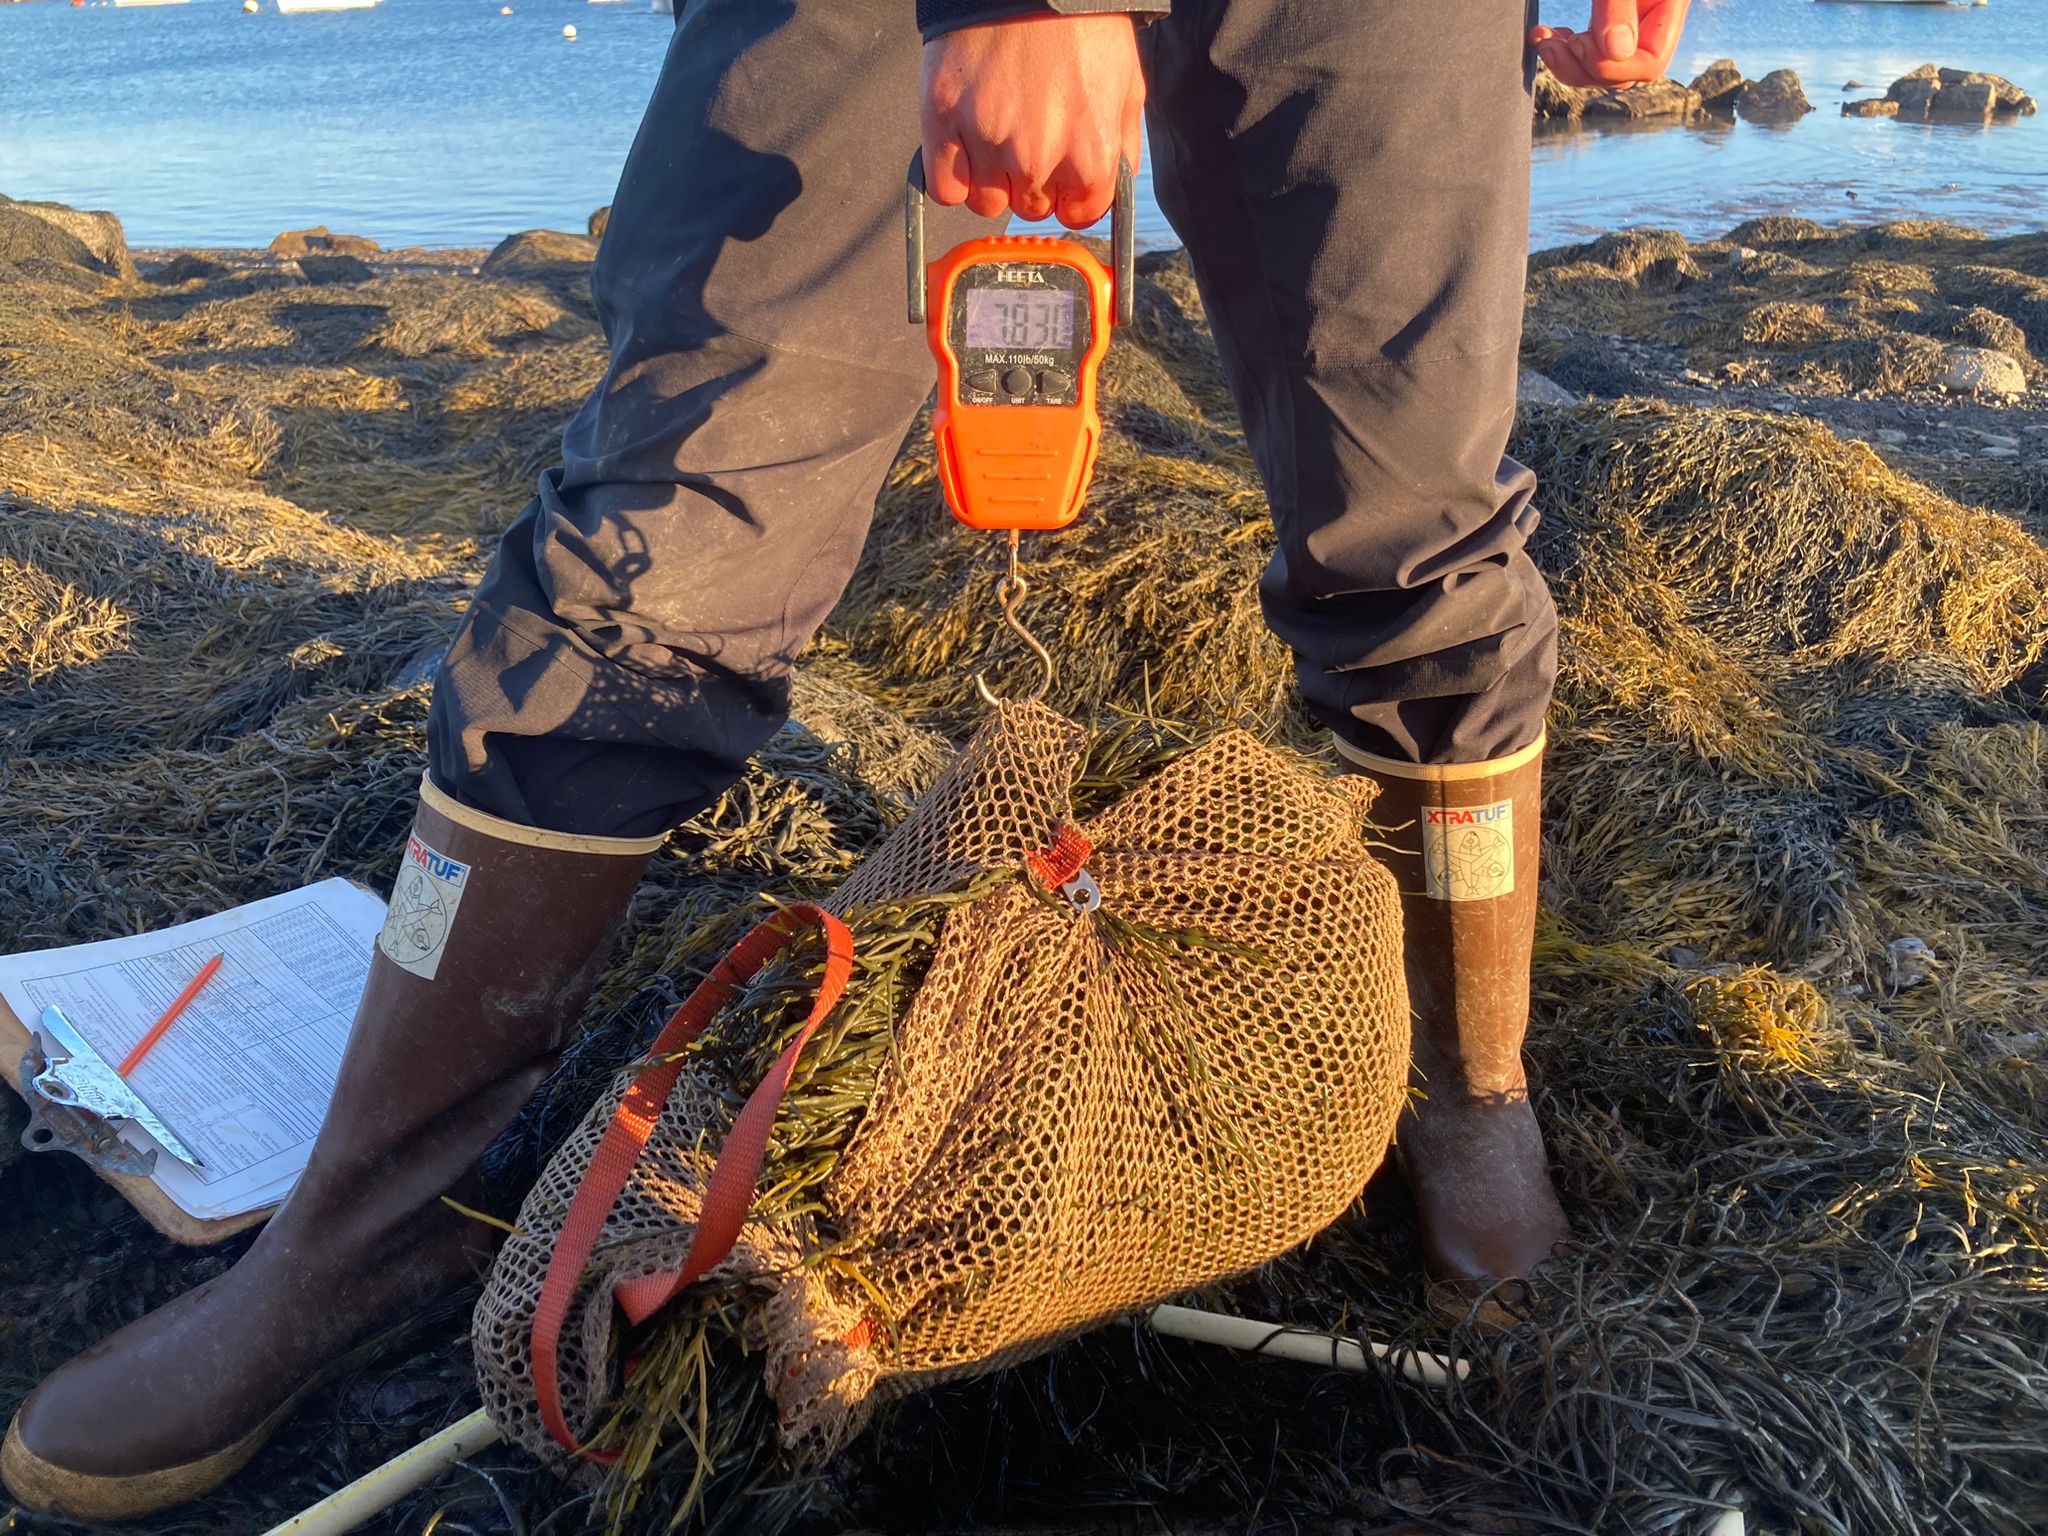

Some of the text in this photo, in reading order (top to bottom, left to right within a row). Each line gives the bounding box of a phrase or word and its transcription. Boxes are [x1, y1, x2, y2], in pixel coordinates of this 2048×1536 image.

[997, 270, 1045, 283] HEETA
[971, 396, 993, 404] ON/OFF
[1011, 396, 1026, 404] UNIT
[1046, 397, 1062, 405] TARE
[1428, 806, 1506, 824] XTRATUF
